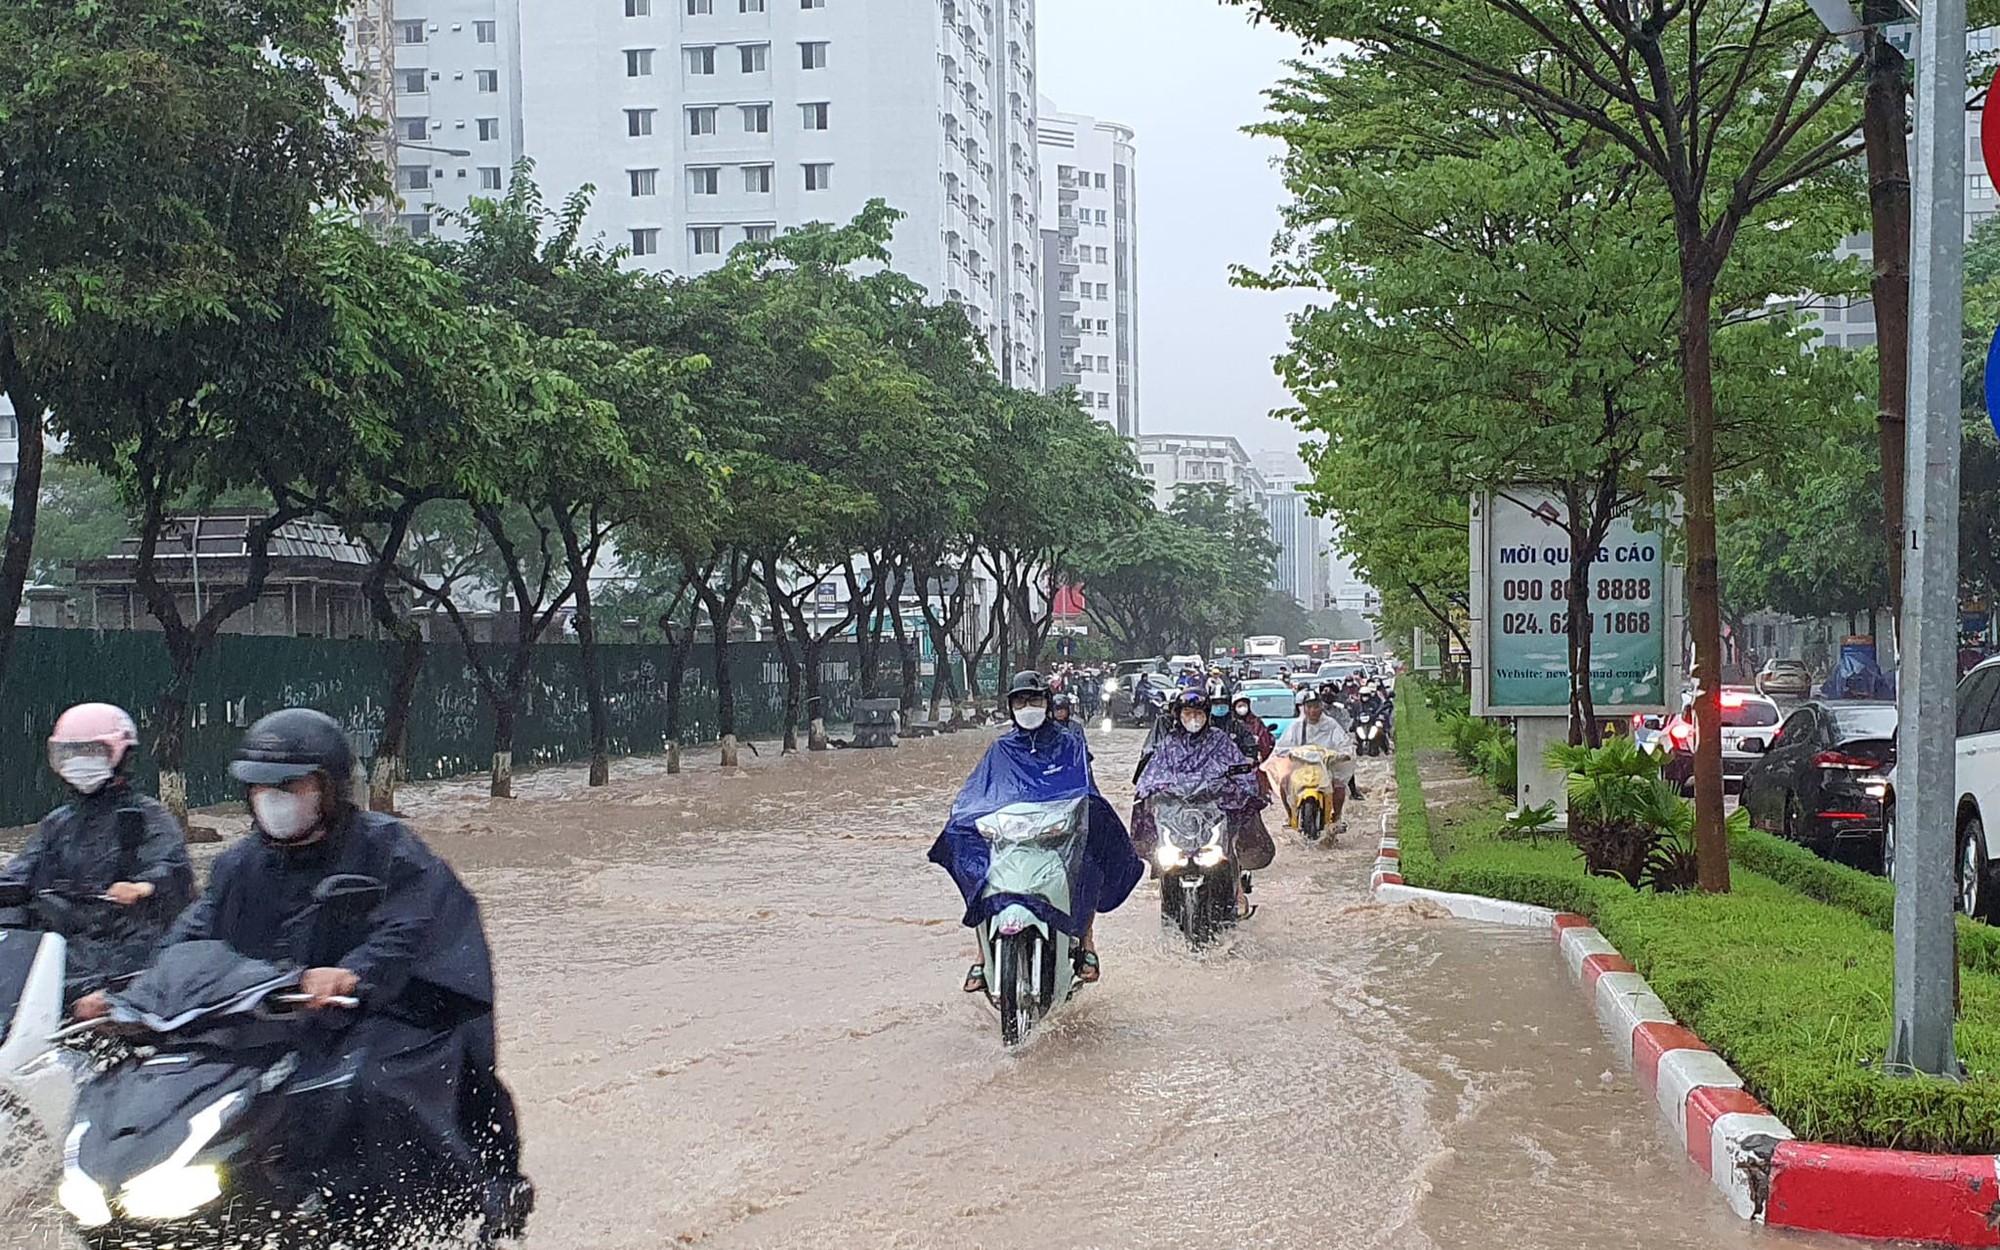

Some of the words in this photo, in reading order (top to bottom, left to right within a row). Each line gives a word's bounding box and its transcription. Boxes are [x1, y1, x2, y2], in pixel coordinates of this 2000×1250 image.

[1500, 544, 1536, 563] MỜI
[1543, 546, 1609, 565] QUG
[1615, 542, 1655, 562] CÁO
[1503, 579, 1543, 601] 090
[1597, 578, 1651, 600] 8888
[1503, 613, 1543, 634] 024.
[1603, 612, 1650, 634] 1868
[1497, 668, 1543, 679] Website:
